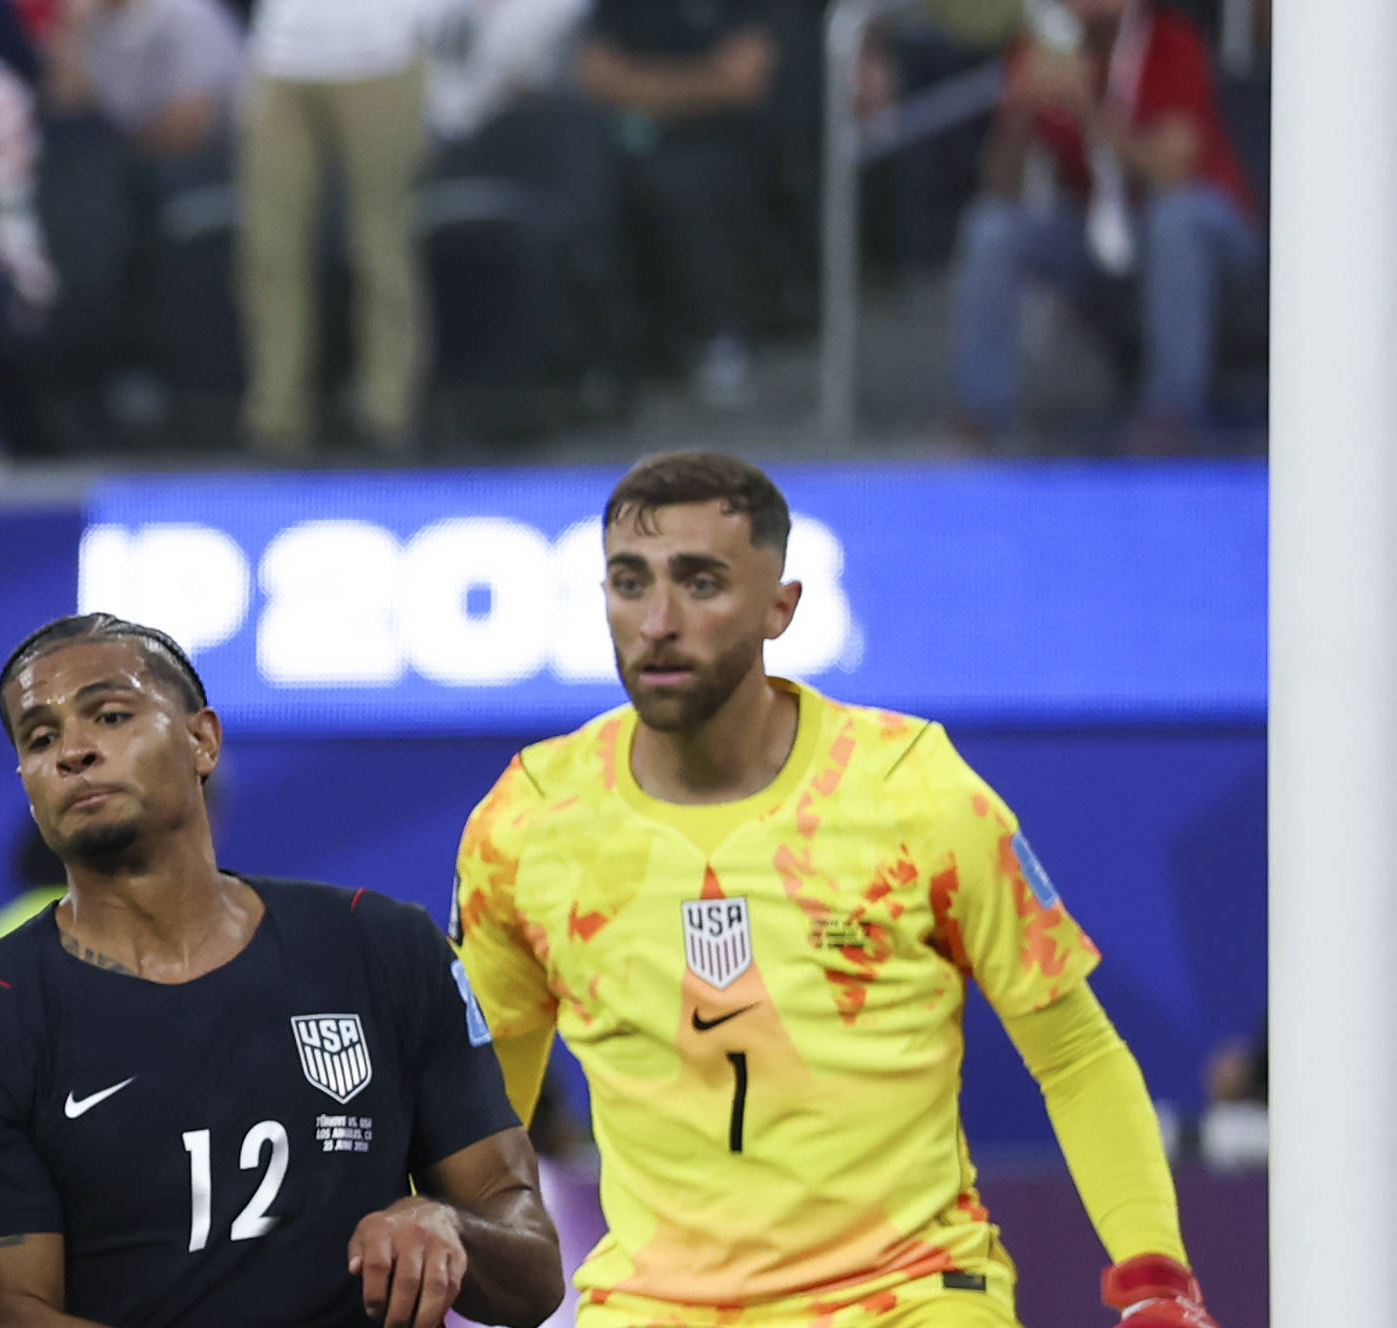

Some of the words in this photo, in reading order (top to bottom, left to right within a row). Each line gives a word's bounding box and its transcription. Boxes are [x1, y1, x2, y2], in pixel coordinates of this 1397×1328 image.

[687, 904, 742, 937] USA
[298, 1020, 359, 1053] USA
[725, 1051, 748, 1154] 1
[182, 1120, 289, 1253] 12
